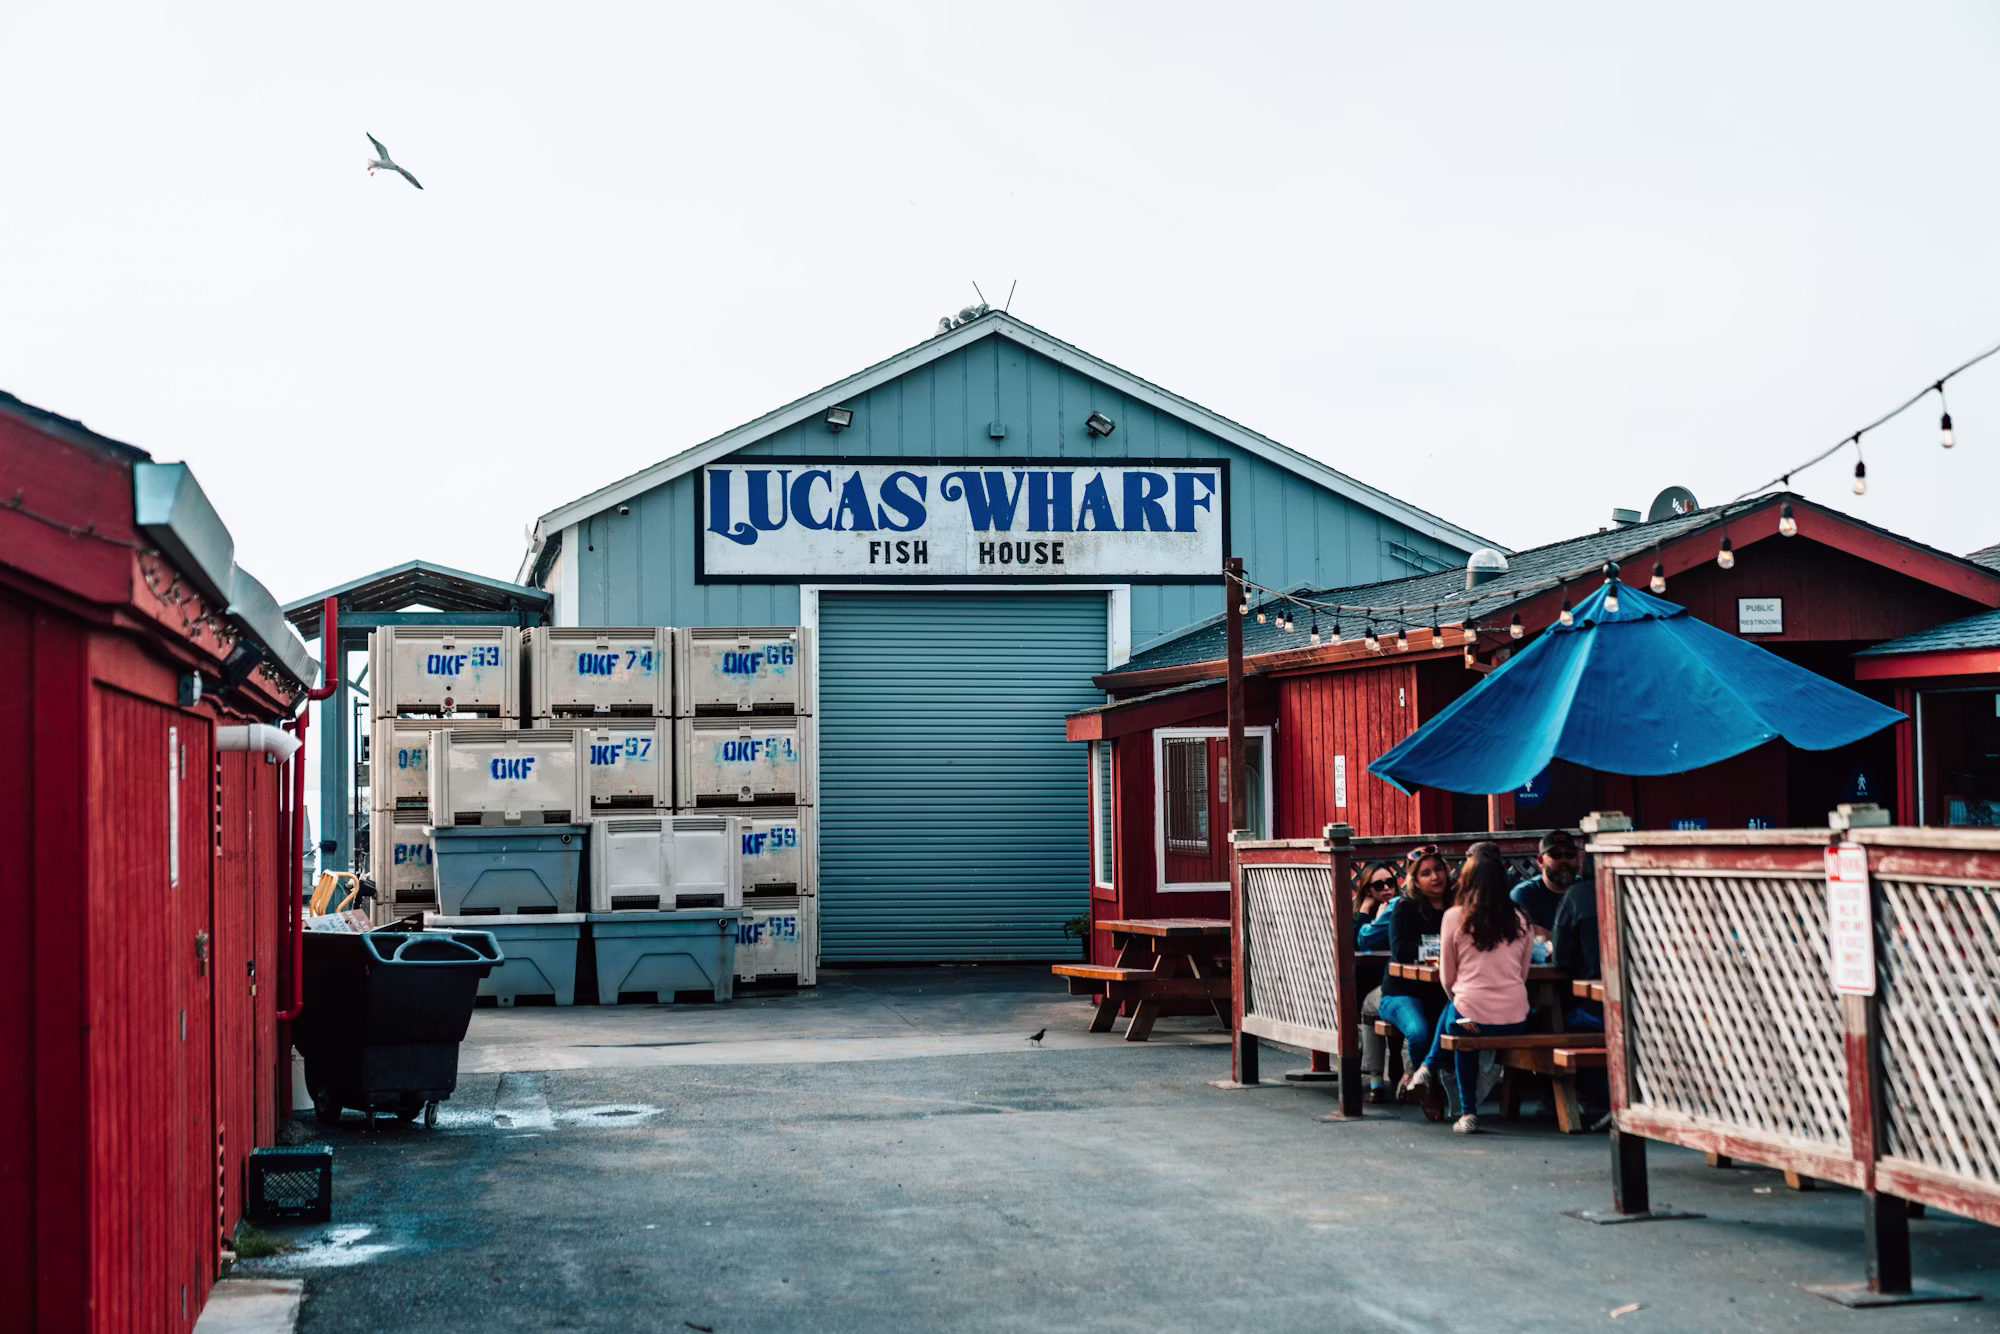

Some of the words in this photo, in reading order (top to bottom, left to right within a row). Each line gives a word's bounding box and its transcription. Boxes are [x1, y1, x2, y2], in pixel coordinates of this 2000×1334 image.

[707, 469, 928, 546] LUCAS
[940, 471, 1216, 533] WHARF
[869, 541, 928, 565] FISH
[979, 542, 1065, 565] HOUSE
[1745, 604, 1775, 612] PUBLIC
[427, 654, 468, 675] OKF
[579, 652, 620, 676] OKF
[625, 650, 653, 671] 74
[723, 652, 764, 675] OKF
[723, 741, 763, 762] OKF
[491, 757, 536, 780] OKF
[735, 923, 766, 944] KF
